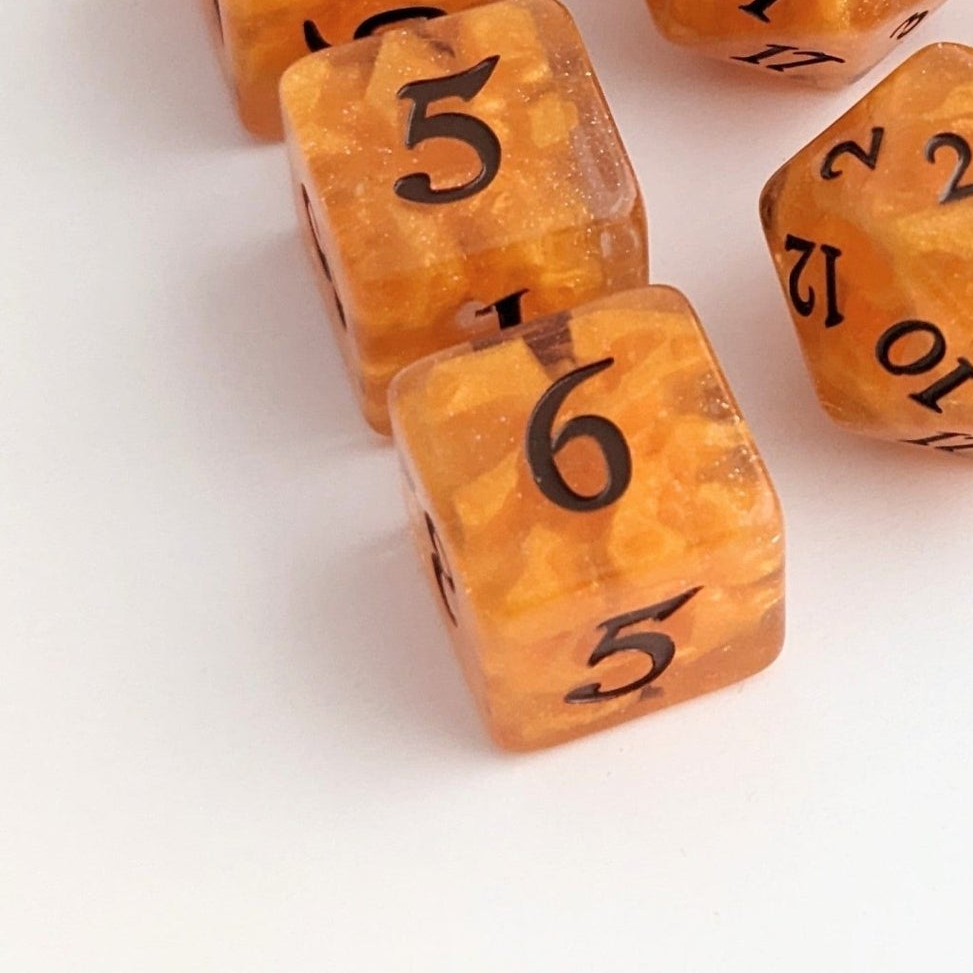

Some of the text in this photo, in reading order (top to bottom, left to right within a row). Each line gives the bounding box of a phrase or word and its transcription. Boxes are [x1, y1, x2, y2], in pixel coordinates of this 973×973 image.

[729, 43, 846, 73] 17
[393, 54, 503, 205] 5
[820, 127, 885, 181] 2
[784, 234, 844, 328] 12
[525, 356, 633, 513] 6
[564, 585, 705, 705] 5
